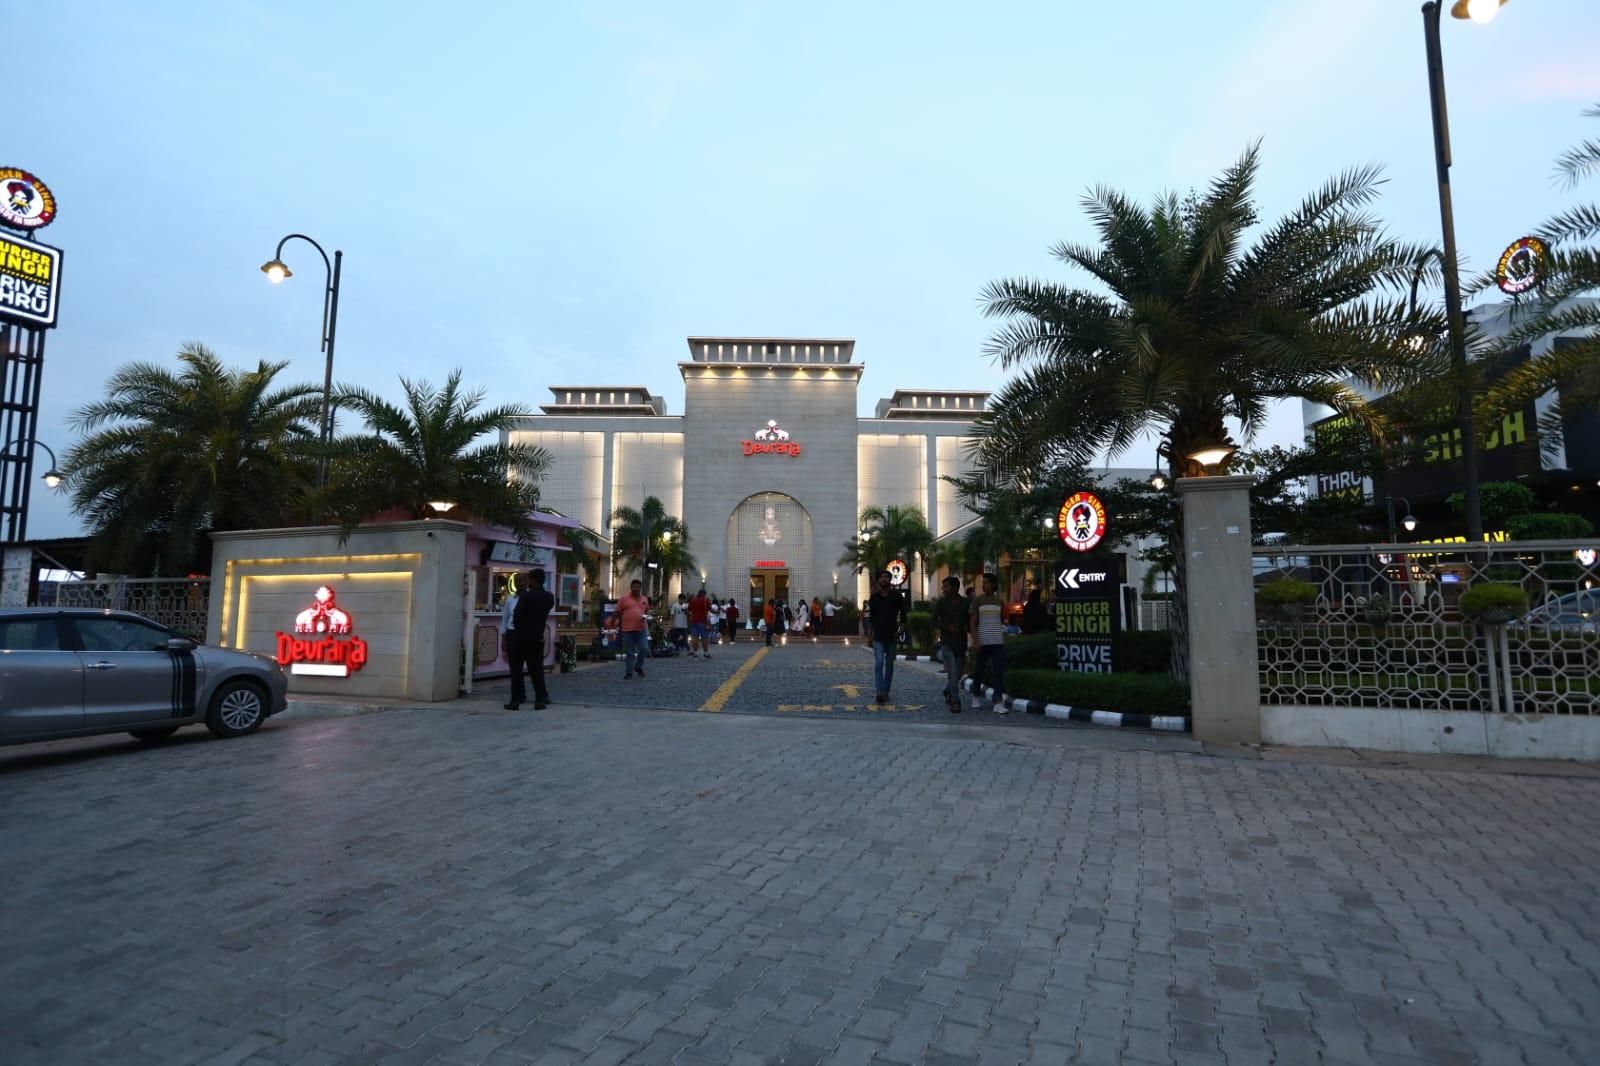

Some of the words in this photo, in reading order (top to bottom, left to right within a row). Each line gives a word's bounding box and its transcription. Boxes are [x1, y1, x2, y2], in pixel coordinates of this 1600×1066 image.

[0, 240, 51, 267] URGER
[0, 252, 50, 279] INGH
[0, 273, 48, 300] RIVE
[0, 287, 47, 313] HRU
[1320, 470, 1362, 493] THRU
[1059, 493, 1081, 529] BURGER
[1088, 495, 1104, 525] SINGH
[1079, 572, 1106, 582] ENTRY
[1056, 602, 1109, 615] BURGER
[1056, 615, 1110, 633] SINGH
[1057, 644, 1112, 663] DRIVE
